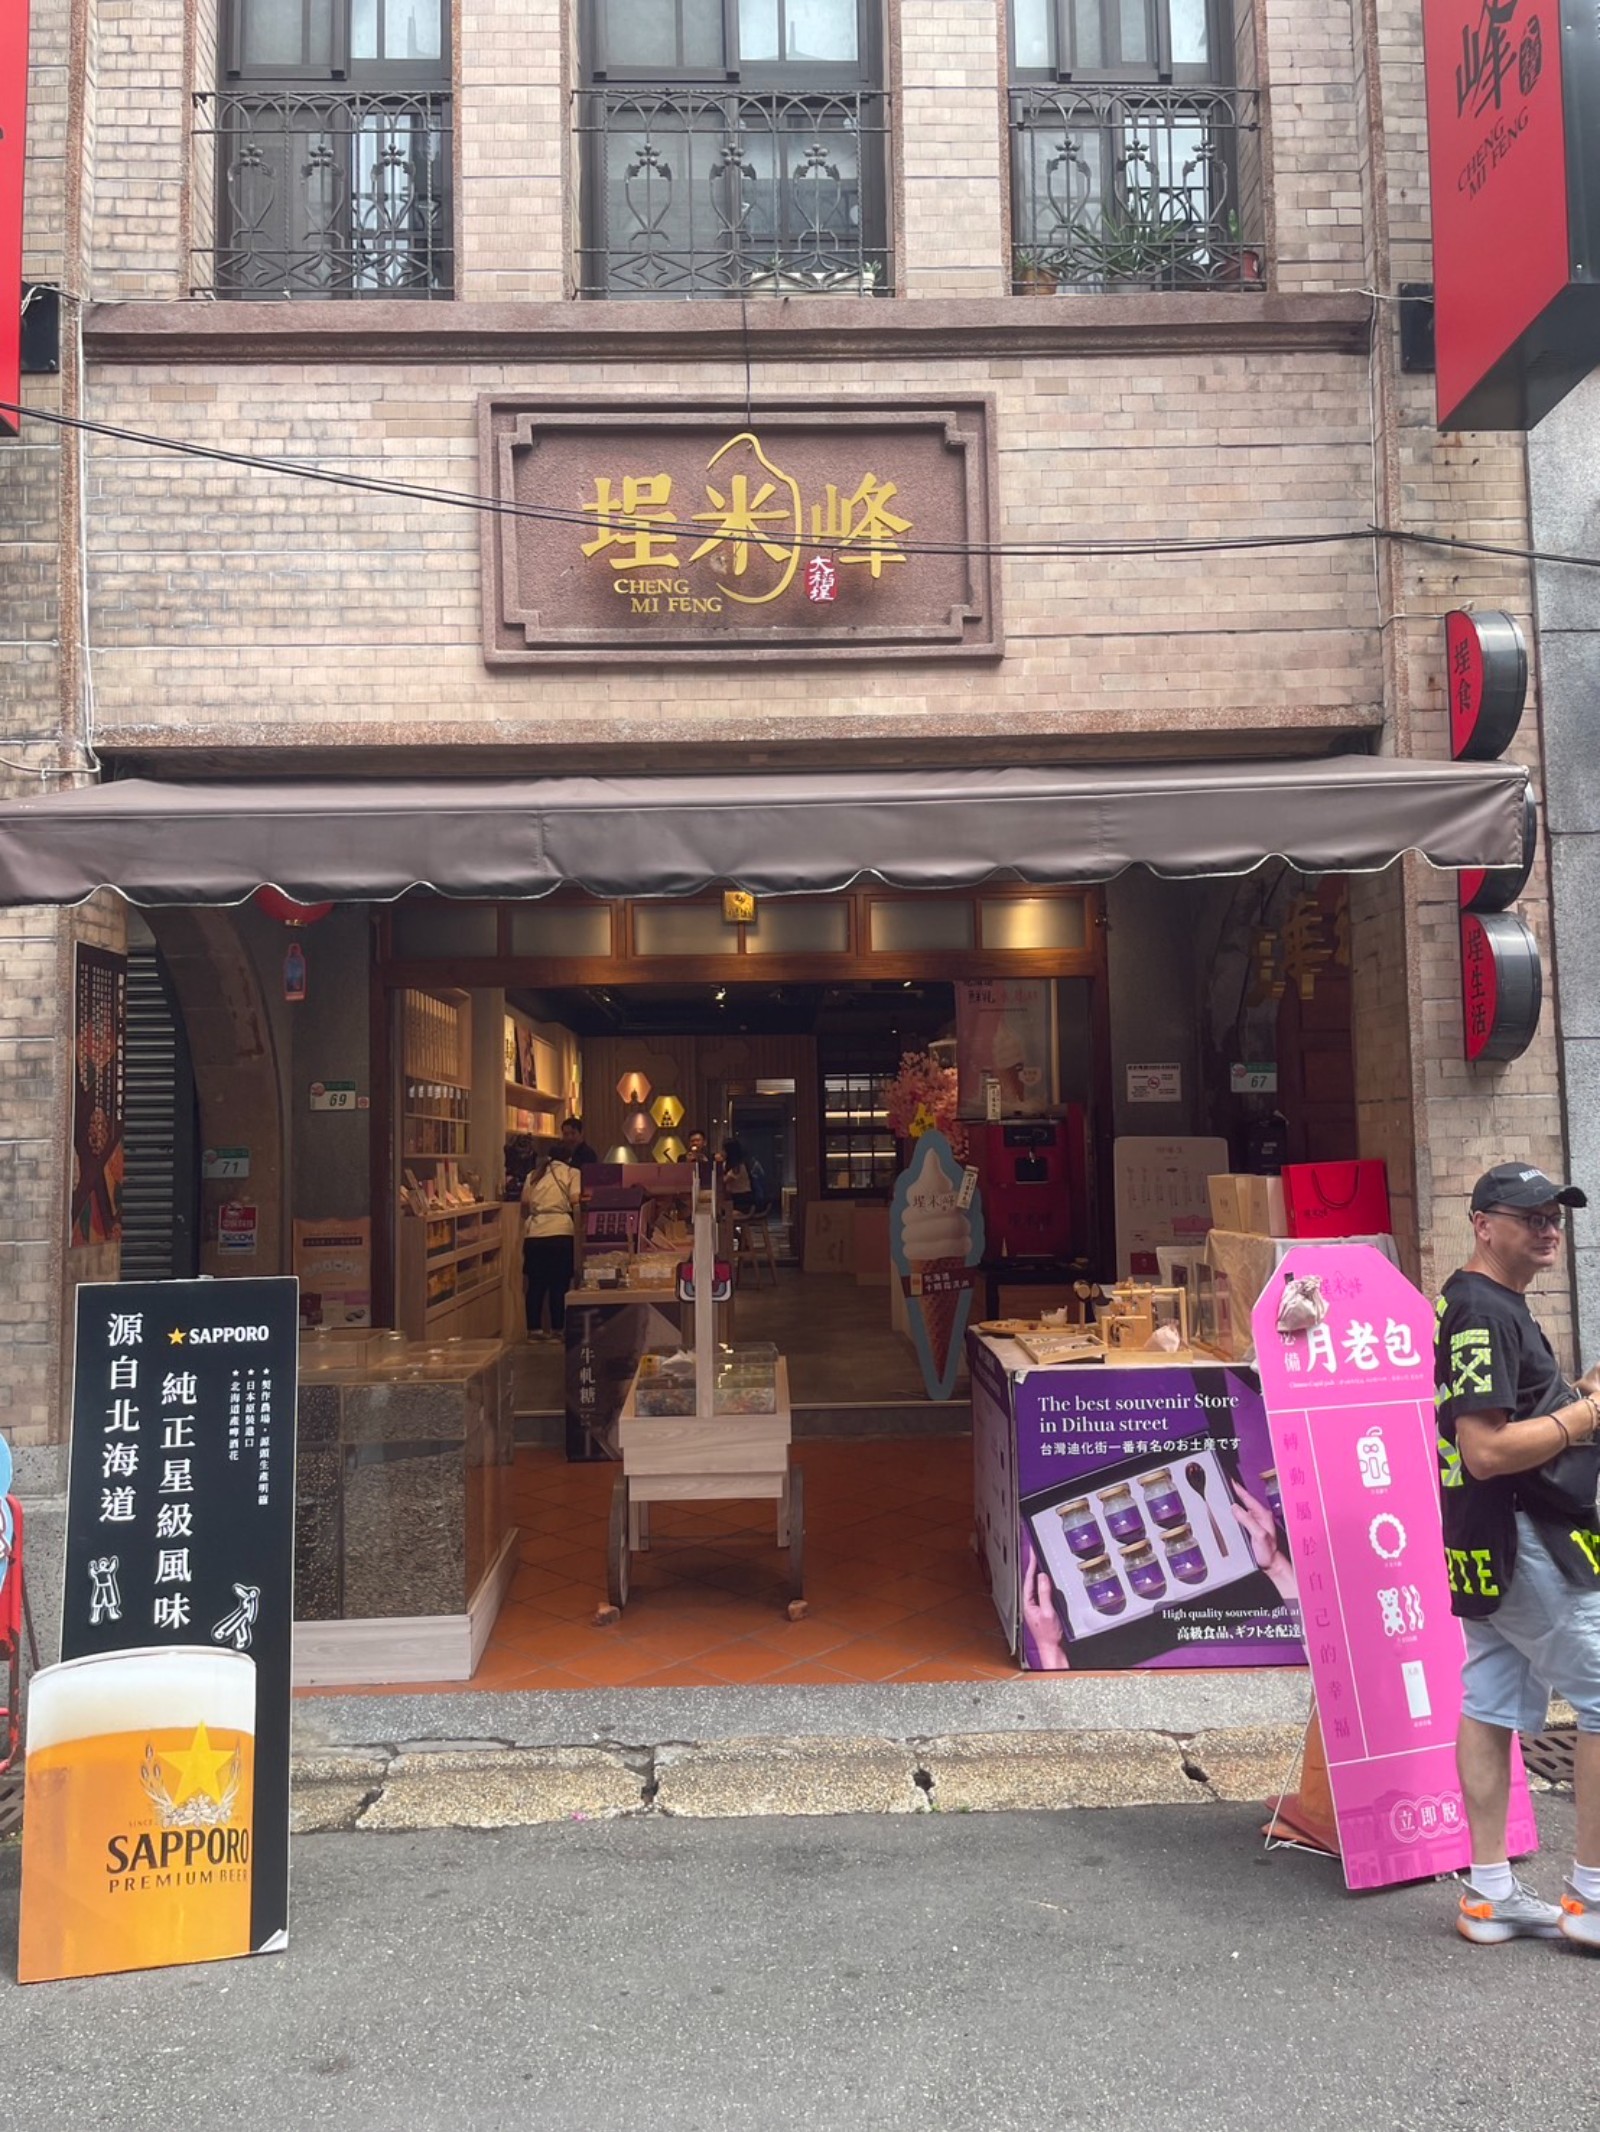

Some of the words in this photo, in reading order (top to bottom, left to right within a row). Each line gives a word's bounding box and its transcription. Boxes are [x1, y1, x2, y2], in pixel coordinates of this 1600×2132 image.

[1457, 116, 1504, 191] CHENG
[1469, 165, 1488, 199] MI
[1491, 106, 1529, 169] FENG
[580, 472, 914, 580] 埕米峰
[613, 579, 692, 596] CHENG
[631, 597, 660, 614] MI
[668, 596, 723, 614] FENG
[1251, 1075, 1267, 1089] 67
[329, 1093, 347, 1107] 69
[222, 1161, 239, 1175] 71
[189, 1325, 270, 1345] SAPPORO
[1306, 1317, 1422, 1374] 月老包
[1037, 1396, 1071, 1412] The
[1075, 1394, 1111, 1412] best
[1115, 1393, 1191, 1411] souvenir
[1194, 1392, 1239, 1408] Store
[99, 1312, 143, 1523] 源自北海道
[1040, 1417, 1057, 1433] in
[1061, 1416, 1115, 1433] Dihua
[1118, 1415, 1169, 1431] street
[153, 1372, 198, 1630] 純正星級風味
[1162, 1609, 1187, 1621] High
[1188, 1607, 1224, 1621] quality
[1271, 1606, 1288, 1619] gift
[1176, 1624, 1303, 1641] 高級食品、ギフトを配達
[106, 1827, 249, 1875] SAPPORO
[109, 1870, 213, 1893] PREMIUM
[219, 1868, 248, 1884] BEER
